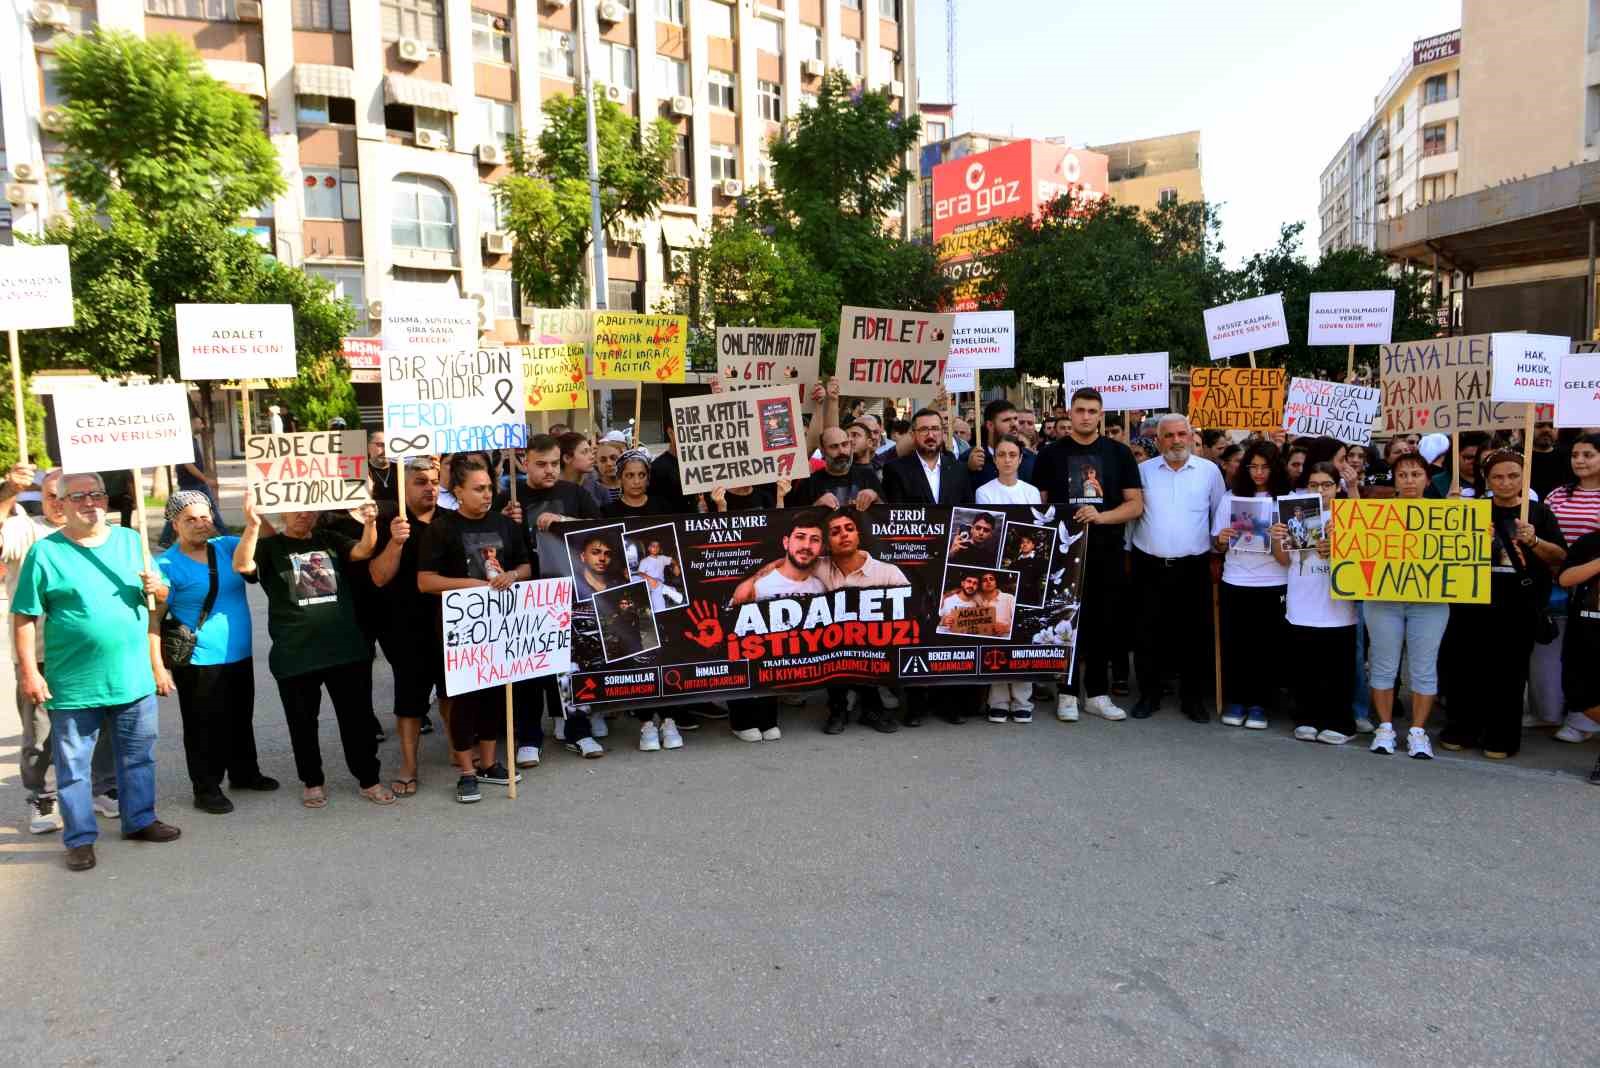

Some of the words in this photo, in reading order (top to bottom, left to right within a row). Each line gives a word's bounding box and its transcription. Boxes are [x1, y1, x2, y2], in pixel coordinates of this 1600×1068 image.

[1419, 44, 1456, 62] HOTEL
[936, 193, 972, 220] era
[977, 177, 1021, 216] göz
[211, 329, 265, 339] ADALET
[853, 316, 929, 343] ADALET
[192, 345, 248, 354] HERKES
[722, 333, 775, 355] ONLARIN
[774, 333, 817, 357] HAYATI
[1524, 351, 1546, 361] HAK,
[743, 361, 752, 380] 6
[757, 361, 776, 380] AY
[1107, 374, 1145, 382] ADALET
[1235, 369, 1286, 386] GELEN
[1517, 363, 1552, 374] HUKUK,
[416, 375, 485, 401] ADIDIR
[1382, 375, 1442, 407] YARIM
[1514, 377, 1553, 388] ADALET!
[1202, 387, 1279, 409] ADALET
[706, 400, 754, 424] KATİL
[1189, 408, 1243, 427] ADALET
[70, 433, 105, 445] SON
[247, 433, 343, 460] SADECE
[707, 440, 750, 460] CAN
[279, 455, 366, 481] ADALET
[685, 517, 728, 532] HASAN
[731, 515, 769, 529] EMRE
[889, 507, 926, 521] FERDİ
[1331, 499, 1409, 531] KAZA
[708, 530, 743, 544] AYAN
[871, 522, 945, 538] DAĞPARÇASI
[1331, 531, 1421, 561] KADER
[690, 561, 705, 571] hep
[706, 558, 728, 569] erken
[524, 582, 571, 609] ALLAH
[734, 586, 912, 636] ADALET
[471, 614, 547, 645] OLANIN
[727, 619, 920, 662] İSTİYORUZ!
[447, 645, 494, 672] HAKKI
[763, 659, 790, 668] TRAFİK
[928, 652, 951, 661] BENZER
[477, 654, 550, 685] KALMAZ
[604, 673, 655, 685] SORUMLULAR
